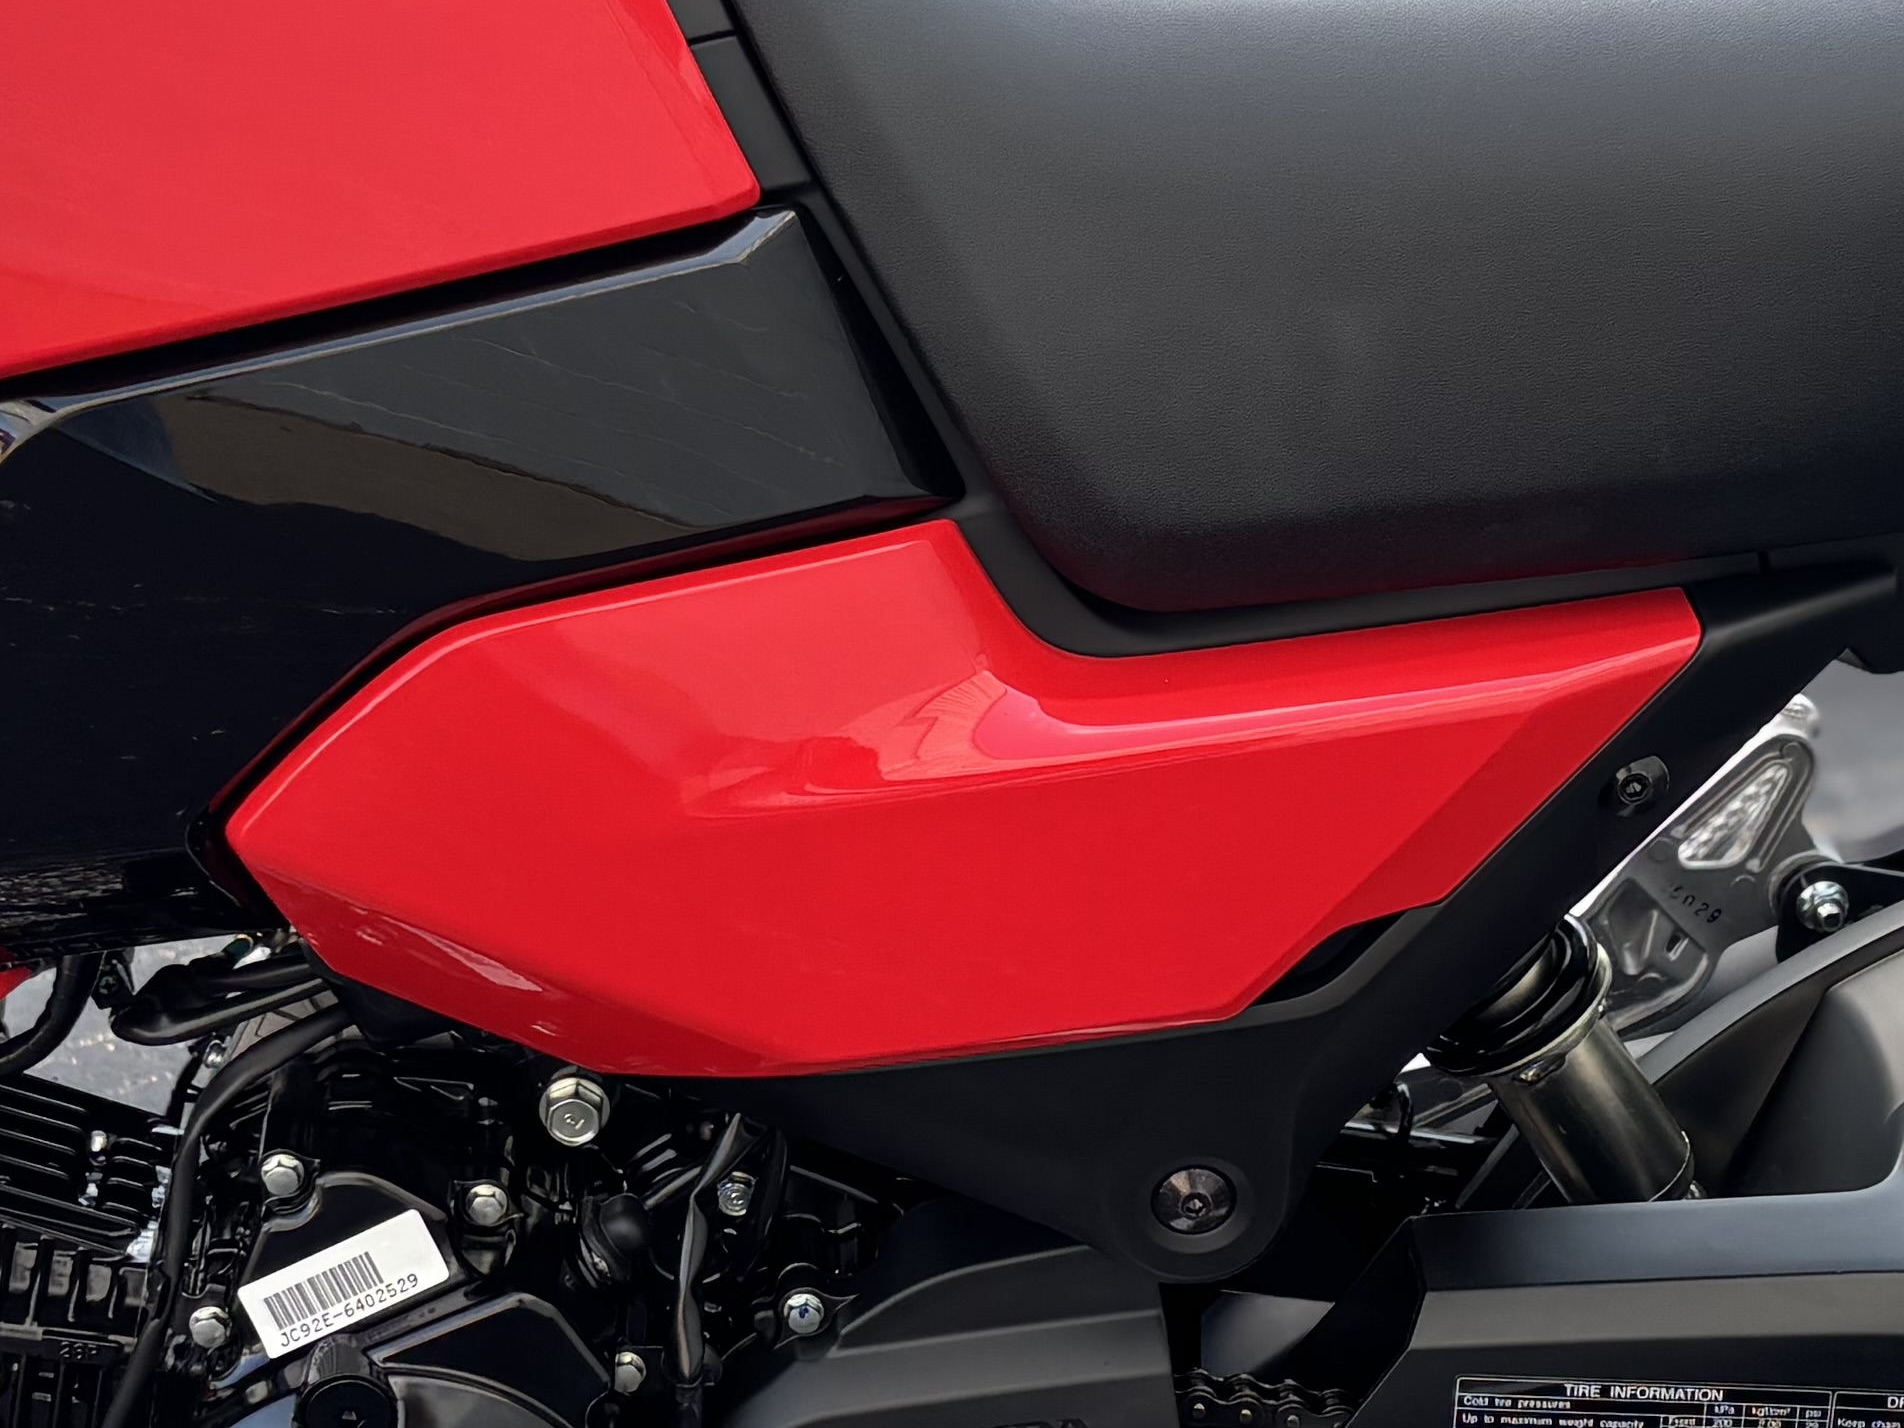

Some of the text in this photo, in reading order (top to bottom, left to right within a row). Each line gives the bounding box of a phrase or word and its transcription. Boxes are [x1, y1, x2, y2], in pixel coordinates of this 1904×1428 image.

[280, 1273, 420, 1348] JC92E-6402529
[1564, 1383, 1724, 1402] TIRE INFORMATION
[1462, 1412, 1478, 1425] Up
[1483, 1413, 1494, 1424] to
